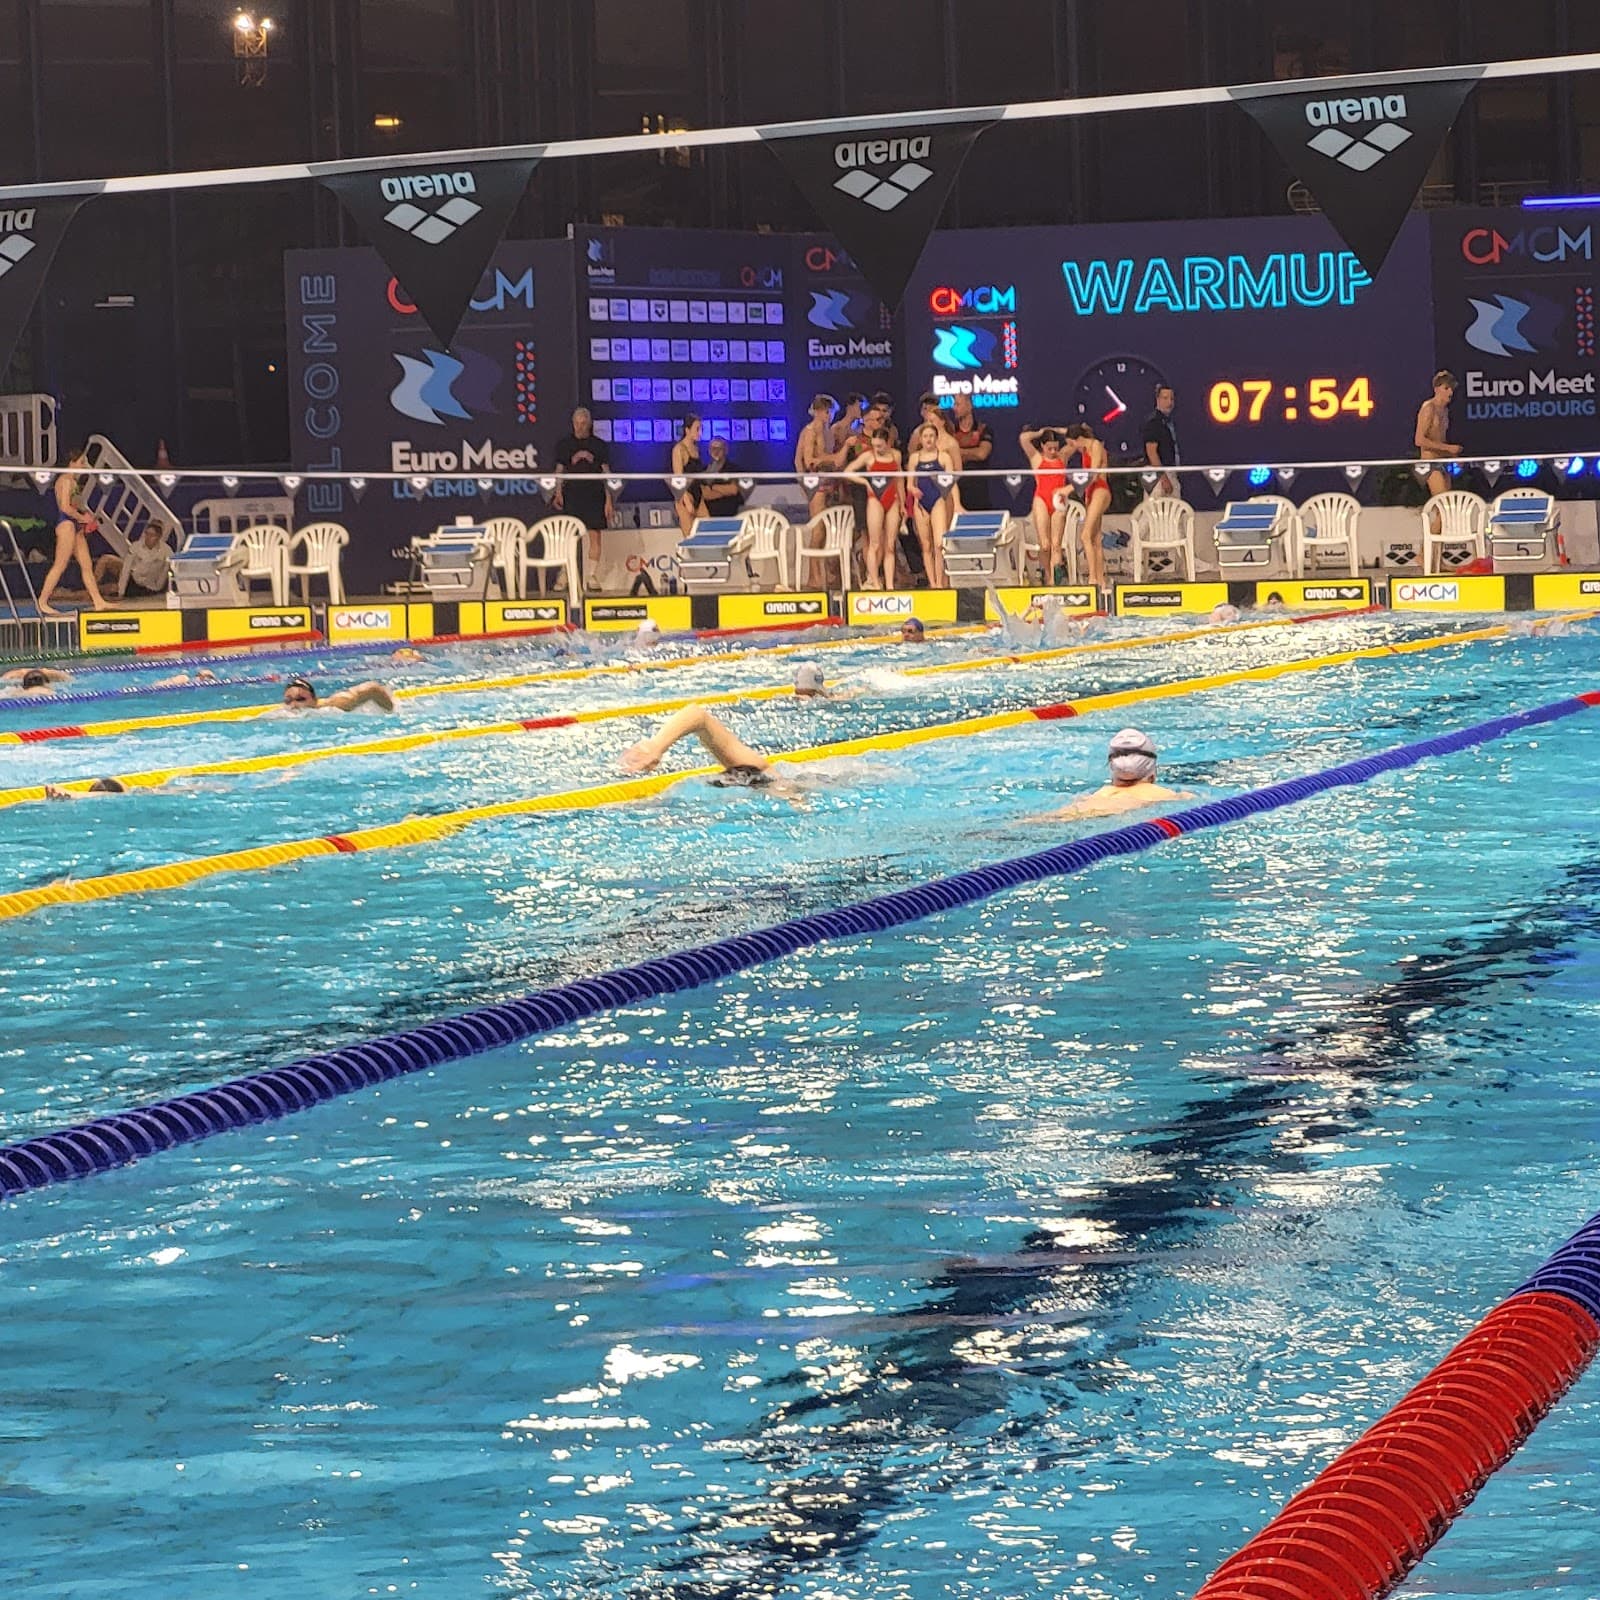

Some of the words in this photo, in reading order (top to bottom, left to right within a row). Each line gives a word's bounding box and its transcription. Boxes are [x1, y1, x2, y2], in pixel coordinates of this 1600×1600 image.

[1305, 95, 1407, 127] arena
[835, 136, 931, 168] arena
[381, 172, 476, 202] arena
[1462, 225, 1593, 264] CMCM
[1062, 251, 1372, 316] WARMUP
[931, 285, 1016, 314] CMCM
[808, 339, 846, 357] Euro
[849, 337, 892, 355] Meet
[301, 275, 342, 512] ELCOME
[933, 375, 971, 395] Euro
[1466, 371, 1525, 397] Euro
[1529, 368, 1595, 395] Meet
[1208, 377, 1375, 423] 07:54
[1466, 399, 1596, 419] LUXEMBOURG
[391, 441, 458, 473] Euro
[462, 438, 538, 471] Meet
[855, 597, 912, 613] CMCM
[1305, 587, 1337, 598] arena
[1399, 585, 1457, 600] CMCM
[335, 612, 390, 628] CMCM
[765, 602, 797, 613] arena
